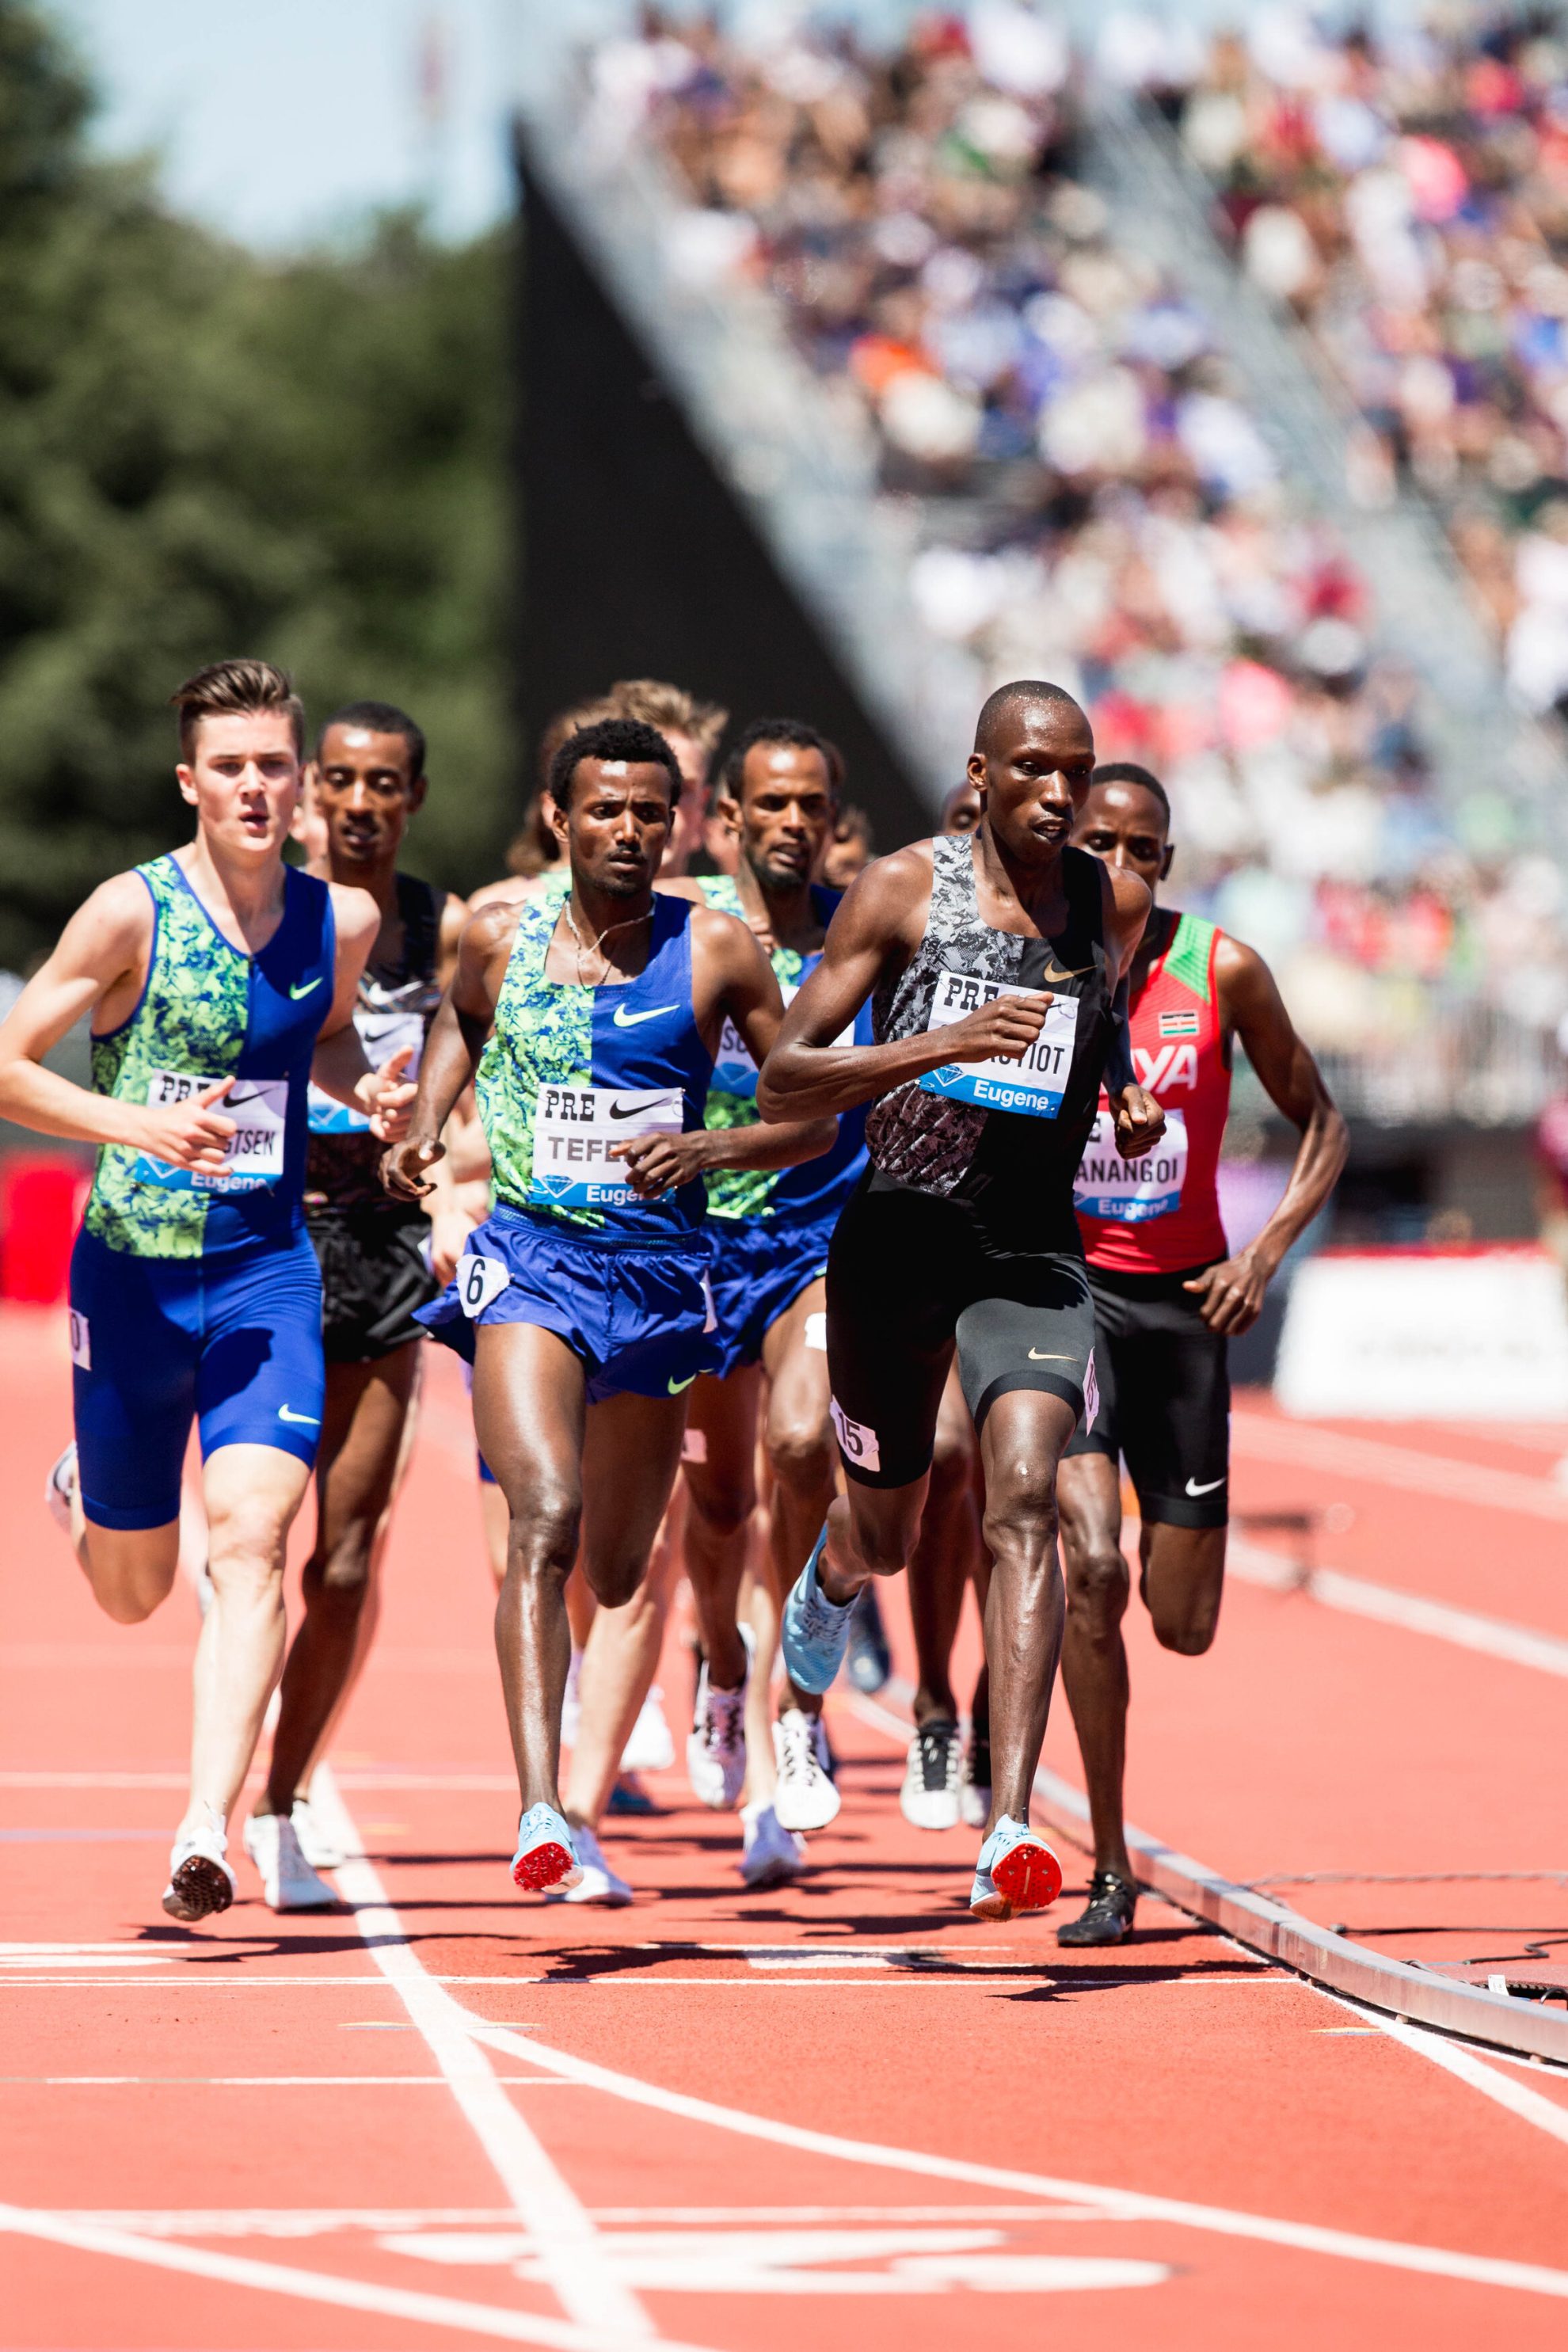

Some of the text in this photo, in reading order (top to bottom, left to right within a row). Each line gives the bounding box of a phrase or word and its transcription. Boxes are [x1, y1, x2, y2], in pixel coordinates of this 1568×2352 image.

[1132, 1043, 1198, 1094] YA
[545, 1090, 595, 1121] PRE
[973, 1079, 1049, 1110] Eugene
[548, 1136, 627, 1163] TEFE
[1075, 1157, 1178, 1183] ANANGOI
[466, 1258, 486, 1306] 6
[838, 1410, 864, 1457] 15
